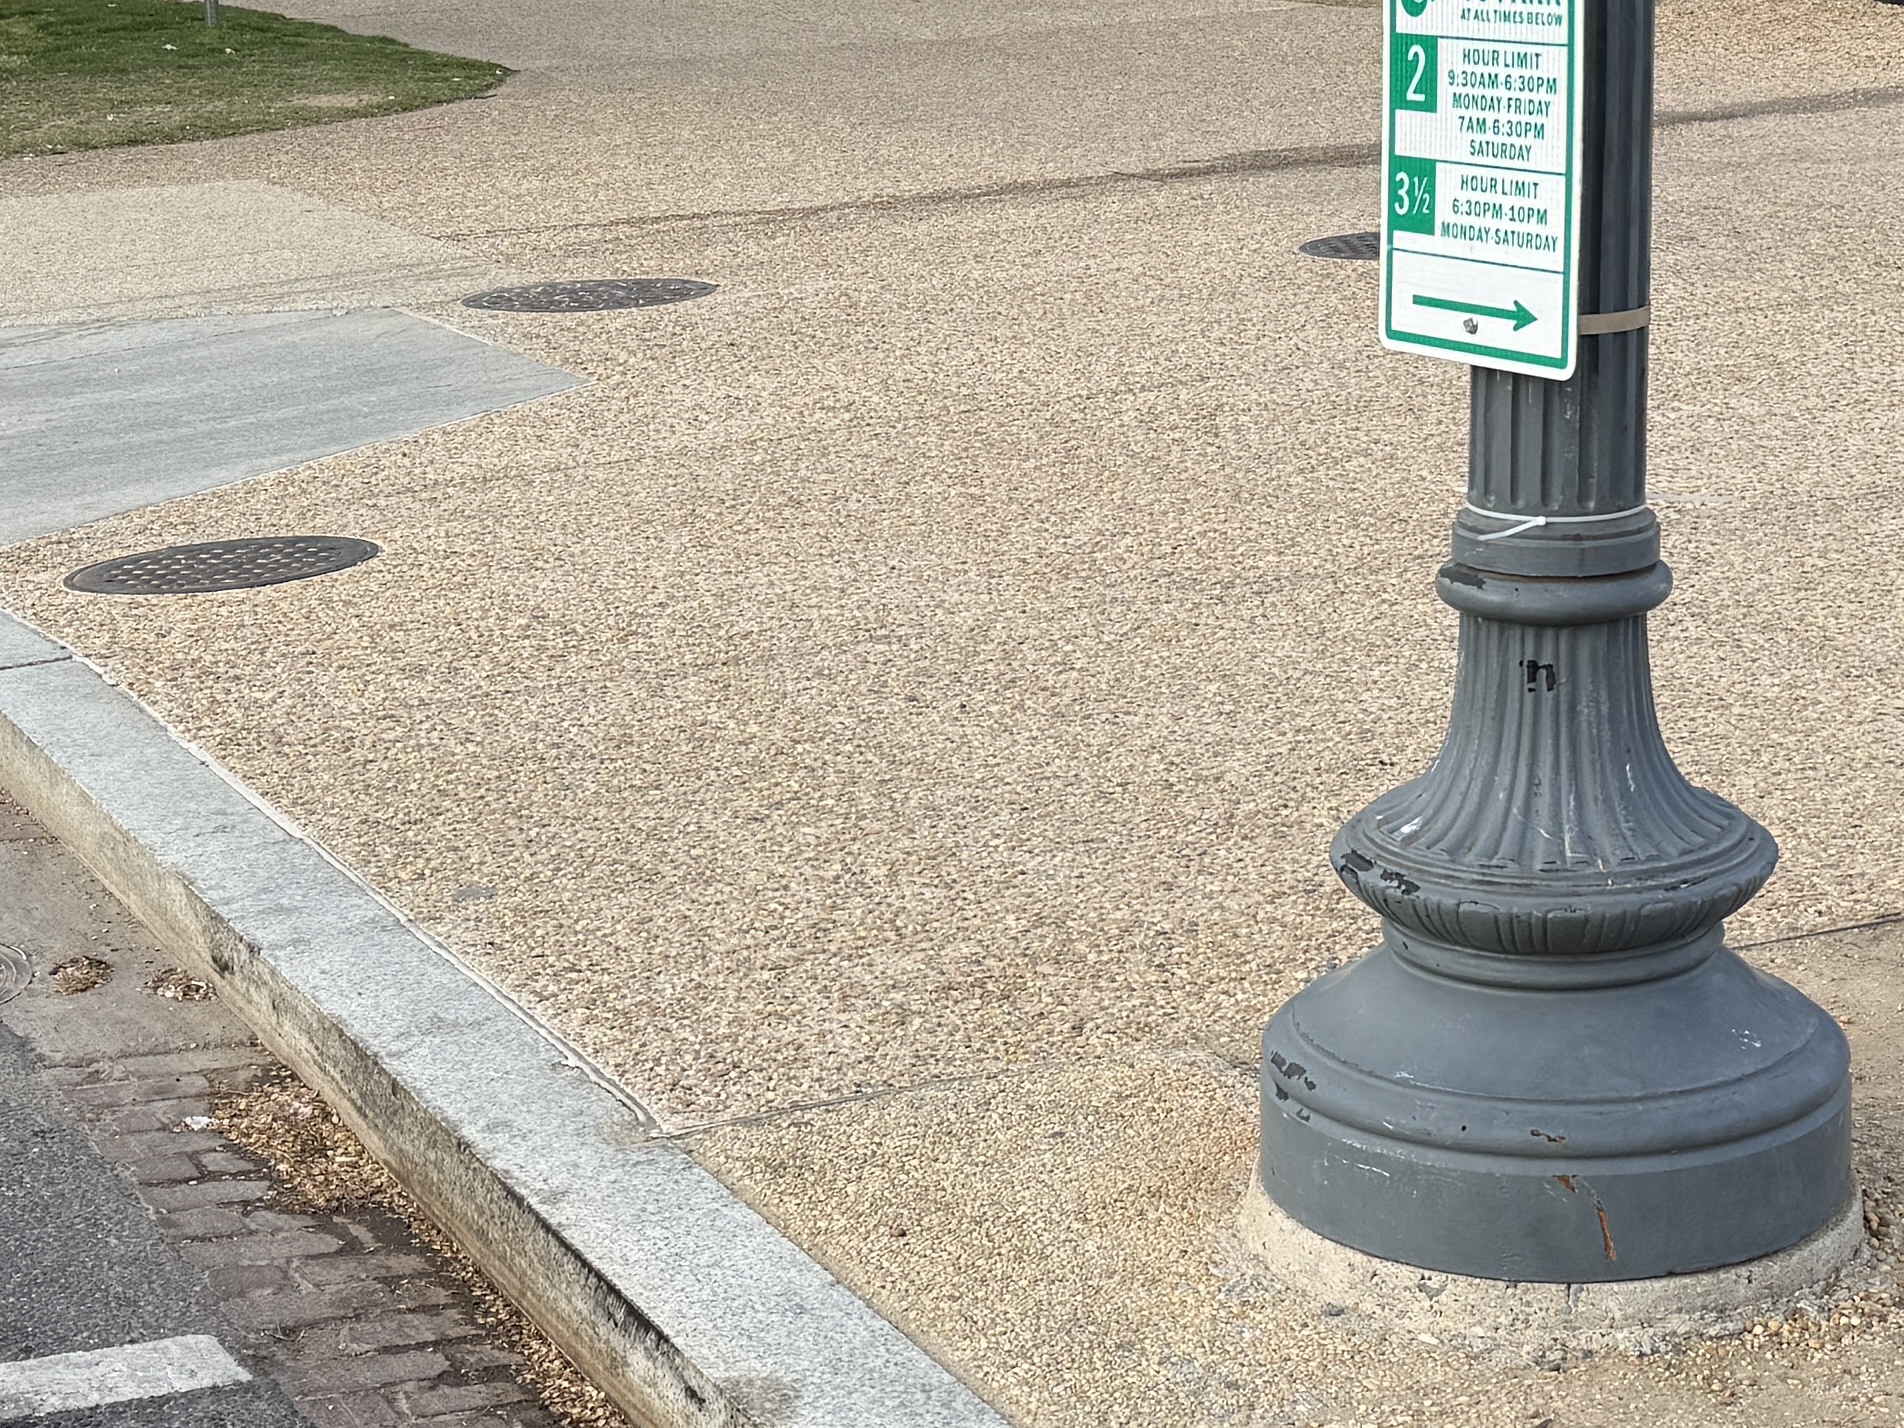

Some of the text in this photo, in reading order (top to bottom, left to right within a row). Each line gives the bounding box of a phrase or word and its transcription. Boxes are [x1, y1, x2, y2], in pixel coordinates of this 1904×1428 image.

[1461, 7, 1563, 27] AT ALL TIMES BELOW
[1463, 48, 1542, 70] HOUR LIMIT
[1406, 44, 1426, 102] 2
[1452, 92, 1551, 118] MONDAY-FRIDAY
[1458, 116, 1545, 140] 7AM-6:30PM
[1469, 139, 1532, 162] SATURDAY
[1460, 174, 1539, 200] HOUR LIMIT
[1452, 198, 1548, 226] 6:30PM-10PM
[1441, 221, 1558, 252] MONDAY-SATURDAY
